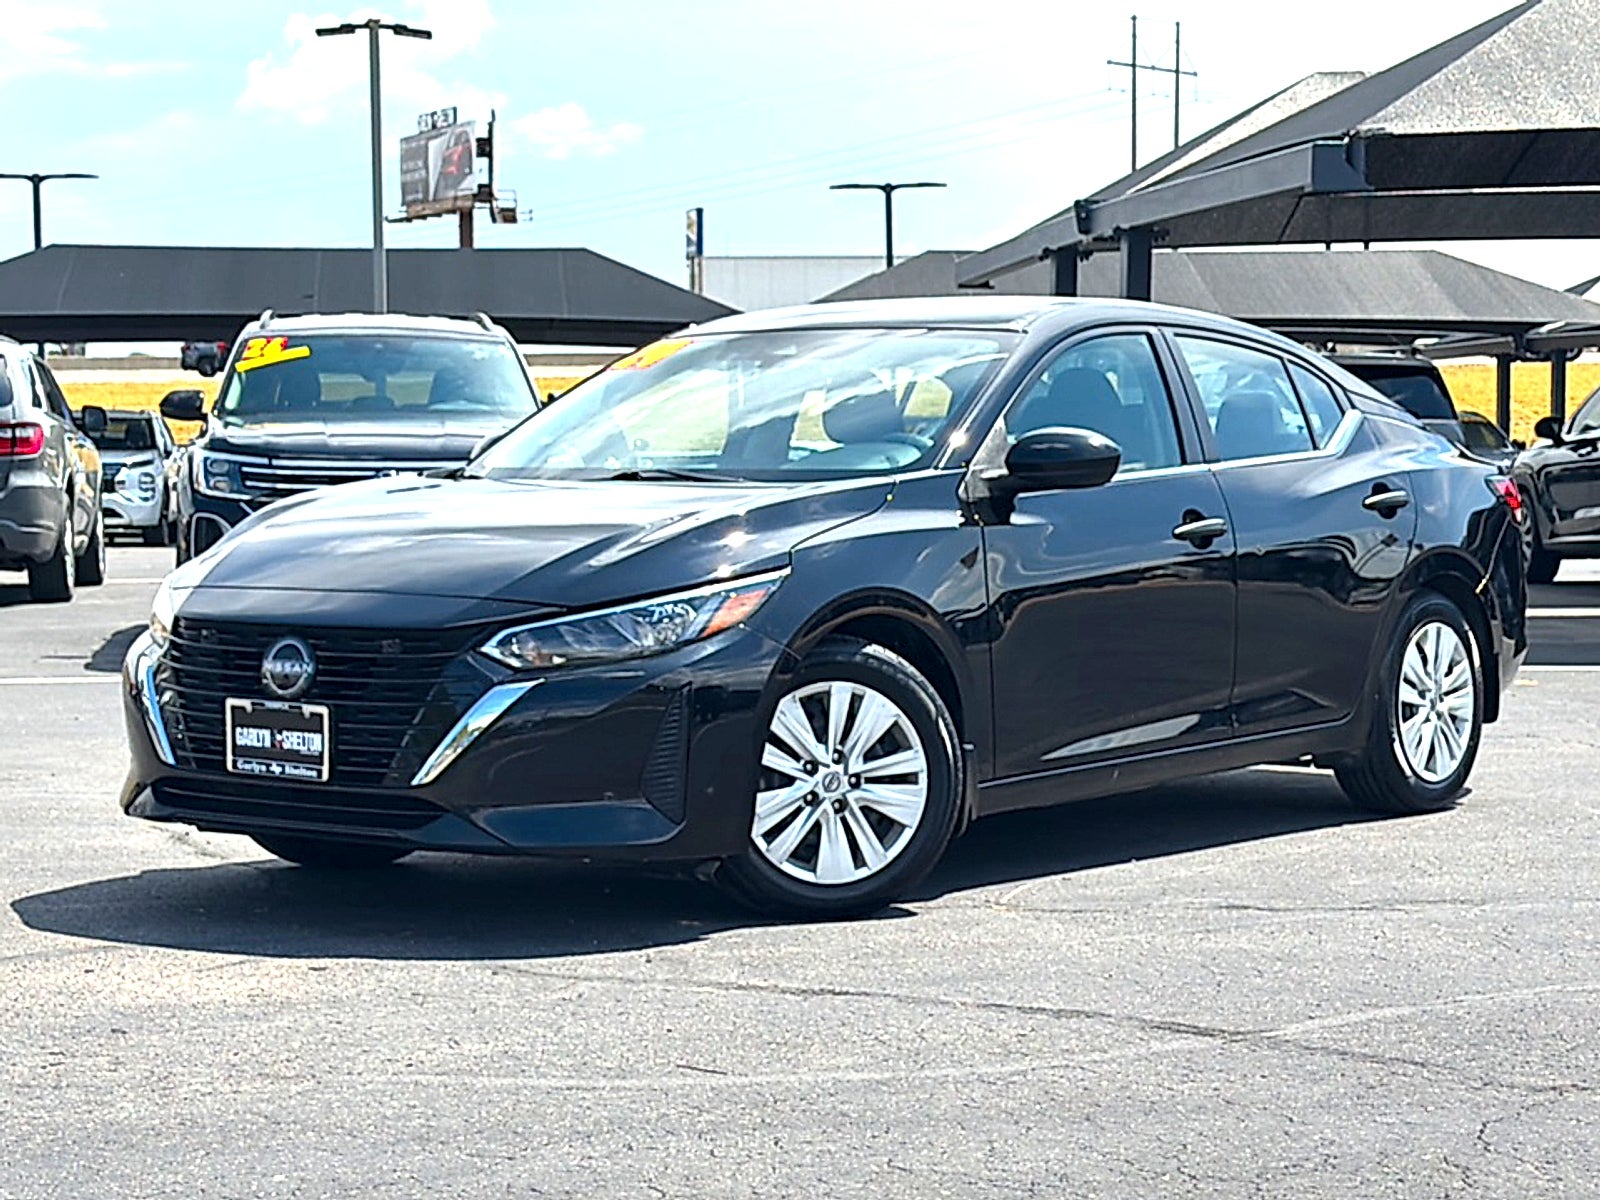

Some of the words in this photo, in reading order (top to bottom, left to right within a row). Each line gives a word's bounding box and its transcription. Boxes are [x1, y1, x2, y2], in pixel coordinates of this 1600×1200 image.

[262, 657, 313, 674] NISSAN
[235, 727, 271, 748] GARLYN
[282, 730, 323, 752] SHELTON
